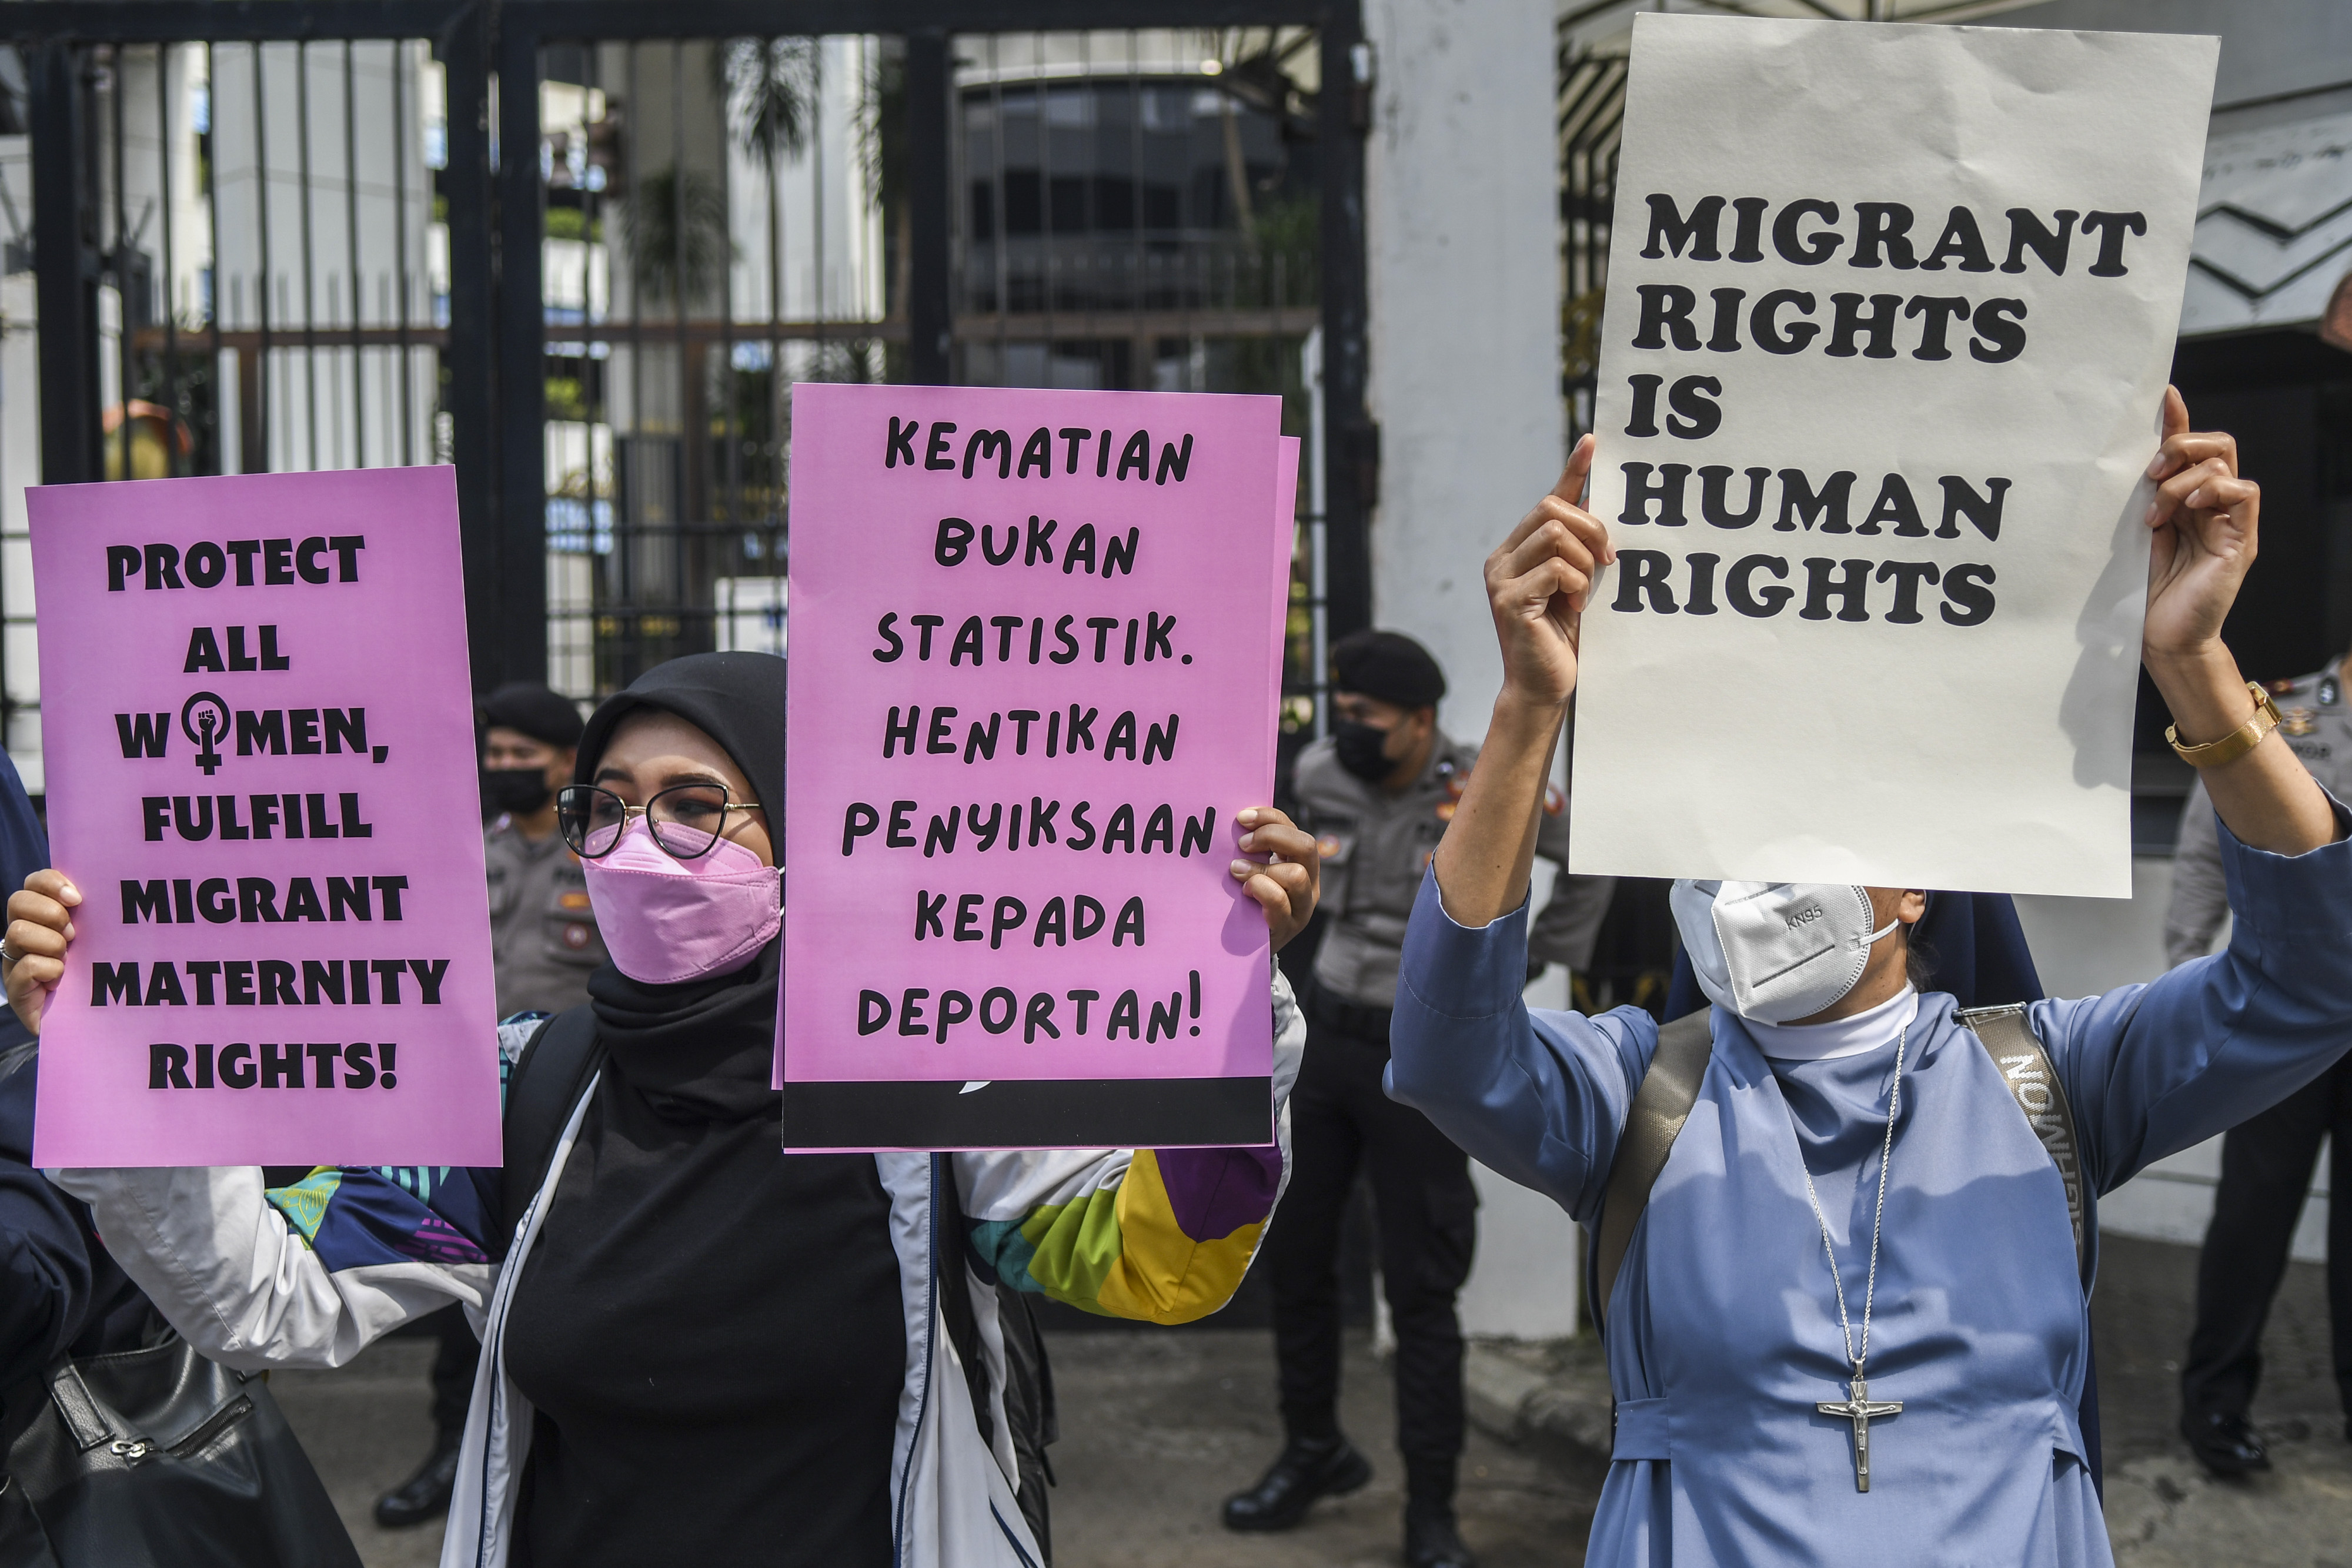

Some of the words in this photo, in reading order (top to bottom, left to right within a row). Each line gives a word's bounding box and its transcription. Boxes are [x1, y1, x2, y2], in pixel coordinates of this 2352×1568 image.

[1639, 193, 2147, 278] MIGRANT
[1631, 283, 2028, 364] RIGHTS
[1623, 373, 1723, 440] IS
[884, 416, 1194, 486] KEMATIAN
[1617, 461, 2013, 543] HUMAN
[105, 534, 366, 593] PROTECT
[934, 514, 1140, 580] BUKAN
[1611, 549, 1997, 627] RIGHTS
[182, 624, 290, 674] ALL
[871, 610, 1193, 667] STATISTIK.
[882, 703, 1180, 766] HENTIKAN
[141, 792, 373, 842] FULFILL
[841, 795, 1217, 859] PENYIKSAAN
[119, 874, 410, 925] MIGRANT
[914, 889, 1145, 951] KEPADA
[1786, 905, 1823, 931] KN95
[89, 958, 452, 1007] MATERNITY
[857, 969, 1201, 1045] DEPORTAN!
[148, 1042, 397, 1090] RIGHTS!
